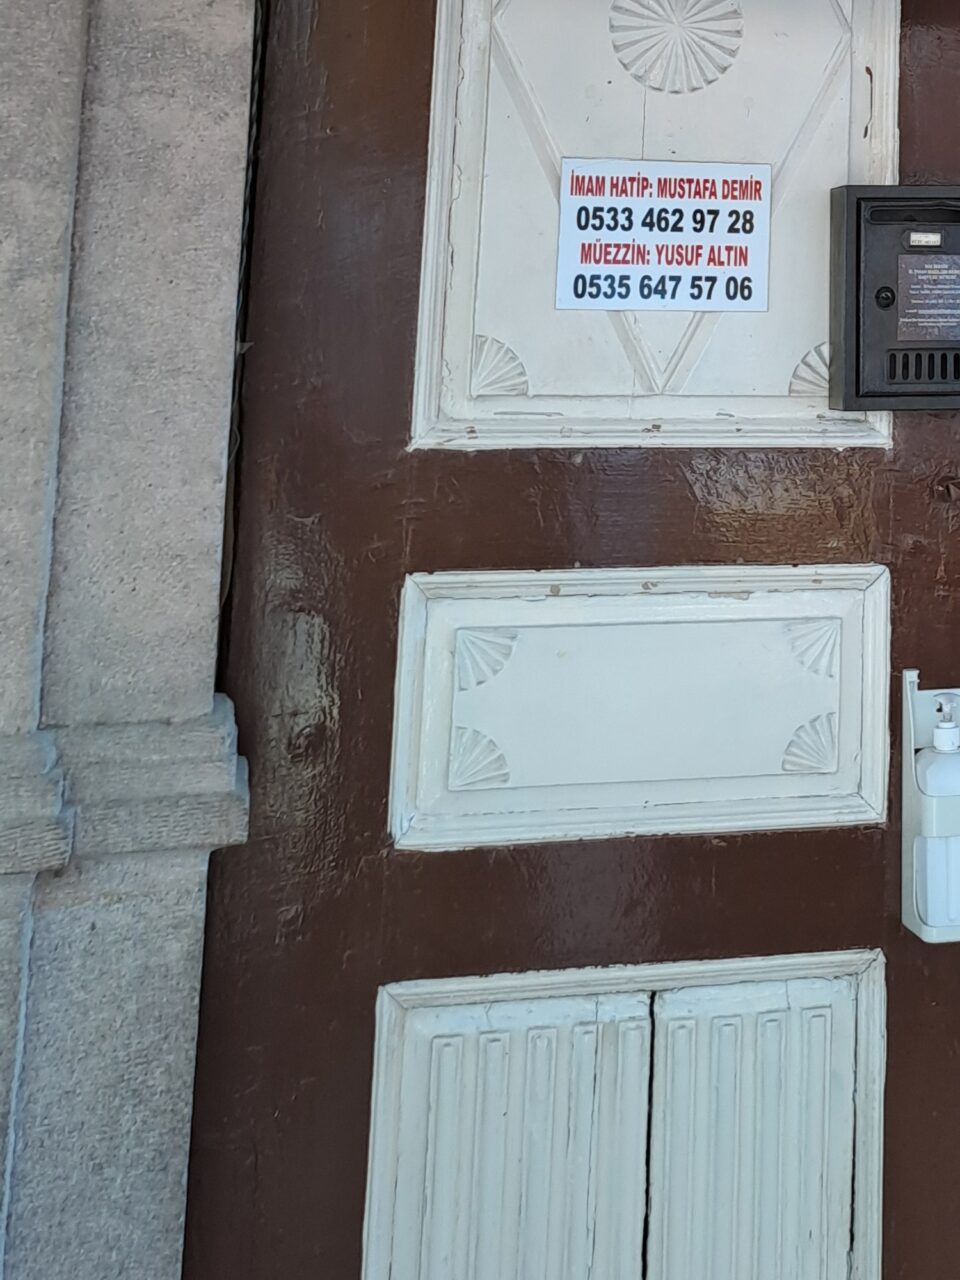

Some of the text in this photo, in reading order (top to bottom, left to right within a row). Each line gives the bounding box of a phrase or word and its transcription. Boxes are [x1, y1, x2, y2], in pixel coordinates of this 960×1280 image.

[570, 170, 762, 201] İMAM HATİP: MUSTAFA DEMİR
[576, 206, 754, 234] 0533 462 97 28
[580, 238, 748, 267] MÜEZZİN: YUSUF ALTIN
[573, 274, 753, 301] 0535 647 57 06
